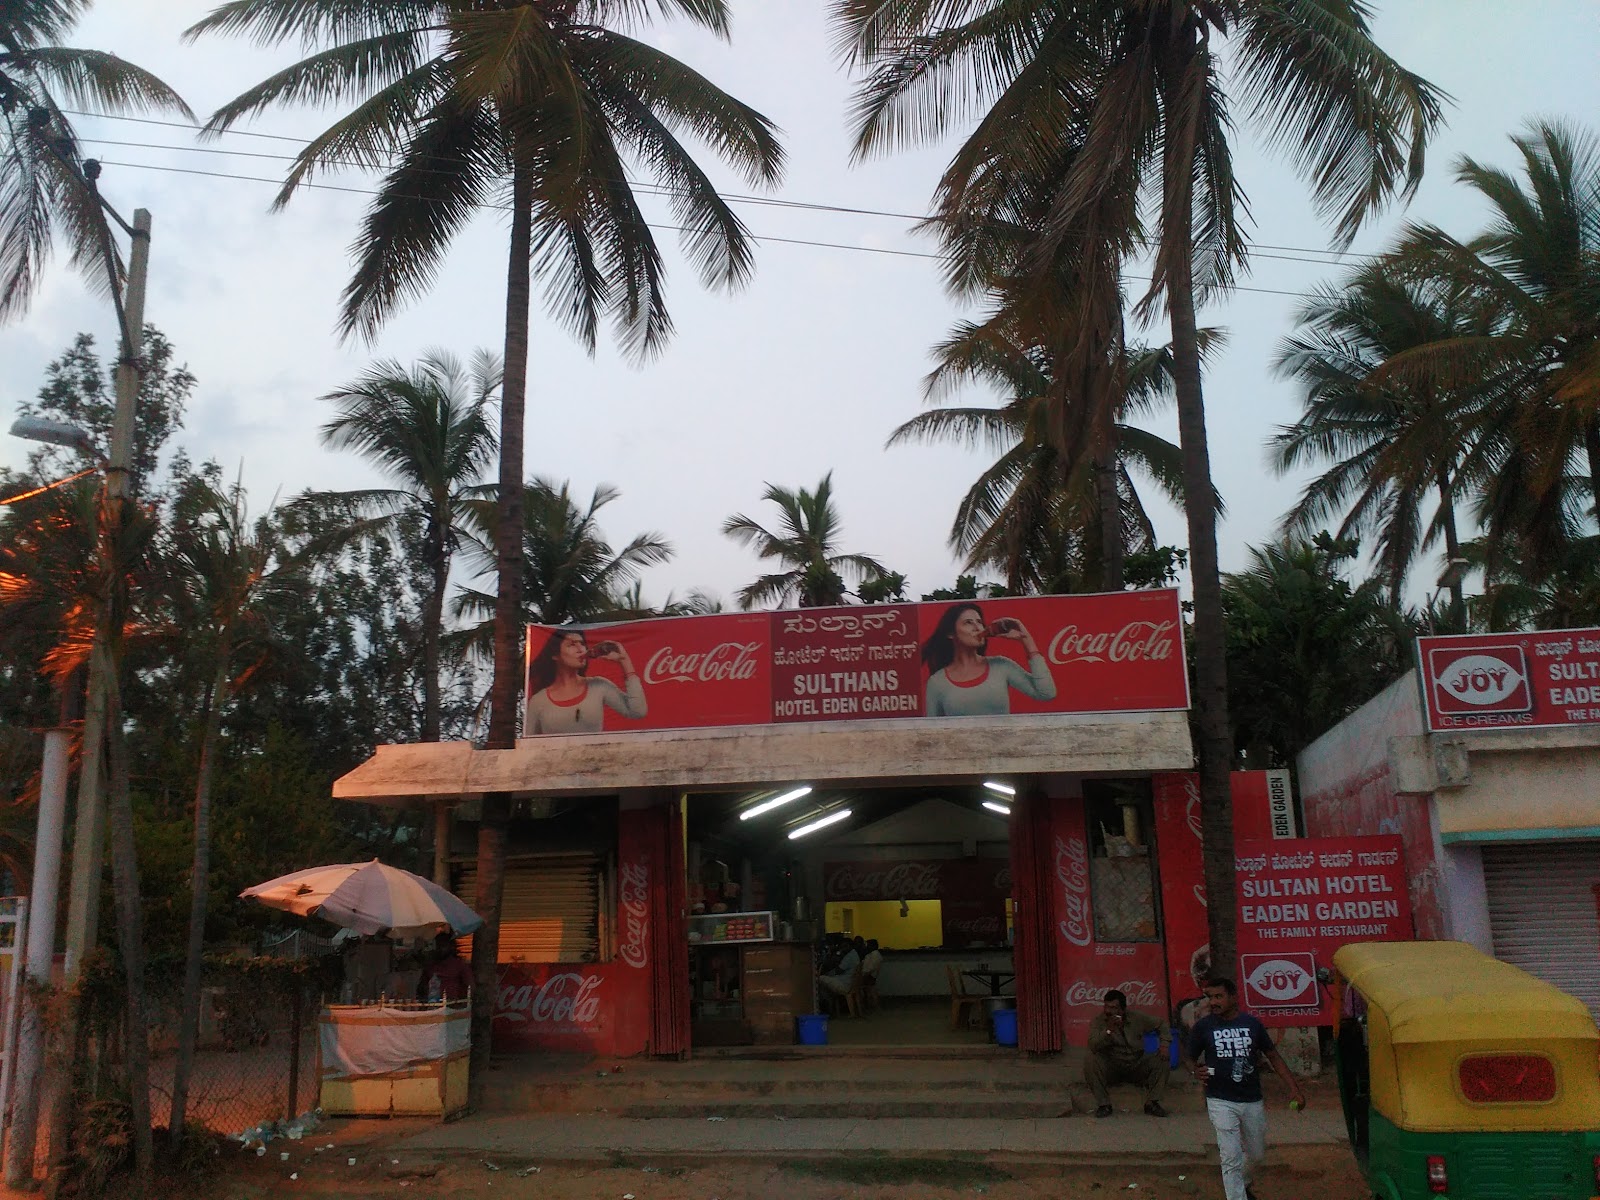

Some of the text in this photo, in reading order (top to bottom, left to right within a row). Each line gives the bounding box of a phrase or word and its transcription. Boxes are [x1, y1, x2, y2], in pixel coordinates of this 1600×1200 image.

[1048, 620, 1178, 665] Coca-Cola
[644, 641, 763, 685] Coca-Cola
[1549, 661, 1600, 681] SULT
[793, 670, 899, 696] SULTHANS
[1451, 667, 1509, 693] JOY
[775, 695, 918, 716] HOTEL EDEN GARDEN
[1565, 709, 1587, 720] THE
[1439, 713, 1534, 726] ICE CREAMS
[1270, 777, 1289, 836] EDEN GARDEN
[1242, 874, 1393, 898] SULTAN HOTEL
[1242, 900, 1400, 923] EADEN GARDEN
[1257, 923, 1388, 939] THE FAMILY RESTAURANT
[1257, 969, 1302, 991] JOY
[1268, 1008, 1320, 1017] CREAMS
[1213, 1027, 1251, 1040] DON'T
[1214, 1037, 1253, 1051] STEP
[1216, 1049, 1233, 1058] ON
